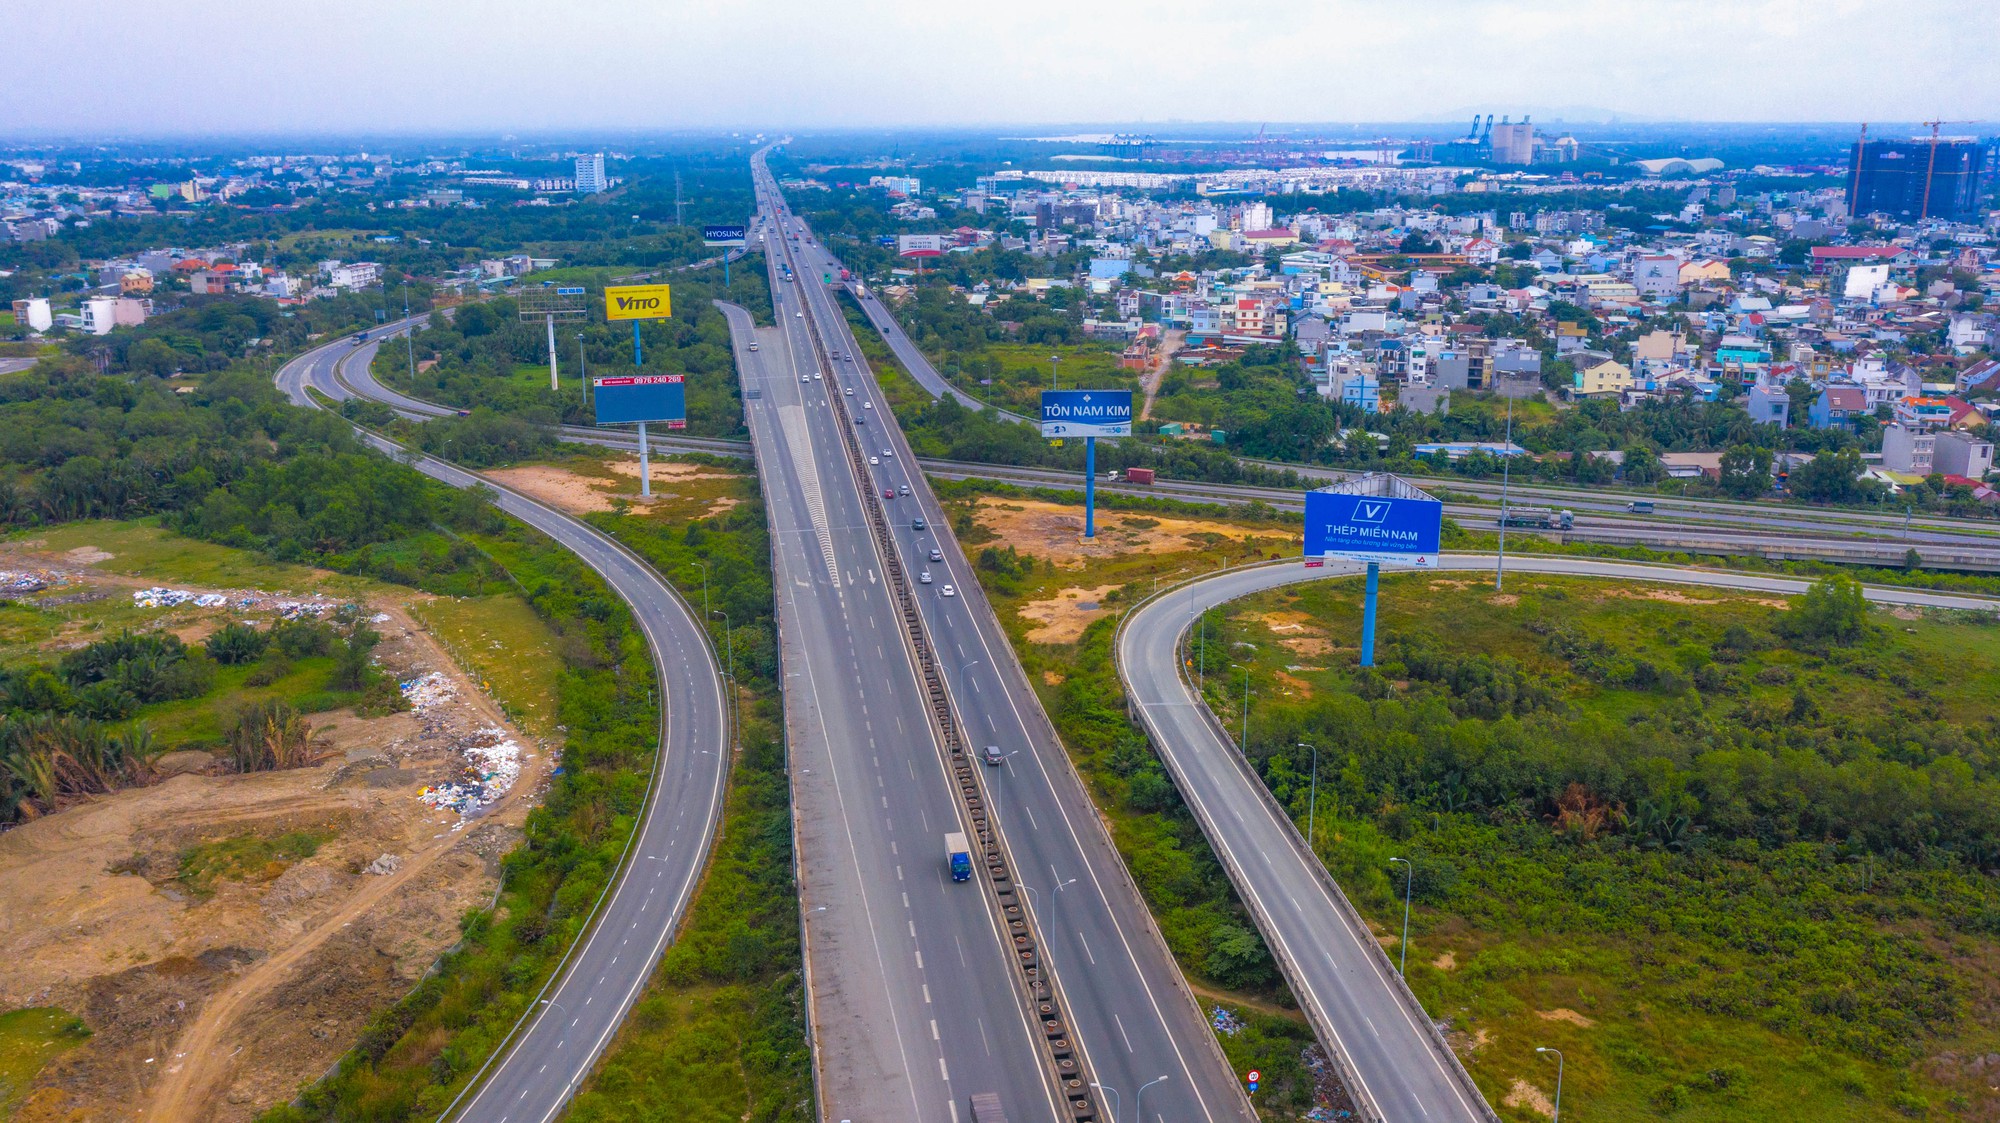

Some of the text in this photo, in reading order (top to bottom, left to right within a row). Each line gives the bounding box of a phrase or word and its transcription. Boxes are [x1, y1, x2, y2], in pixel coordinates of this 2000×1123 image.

[706, 230, 743, 238] HYOSUNG
[653, 376, 667, 384] 240
[1044, 403, 1130, 417] TÔN NAM KIM
[1365, 504, 1382, 519] V
[1325, 523, 1358, 536] THÉP
[1391, 529, 1418, 541] NAM
